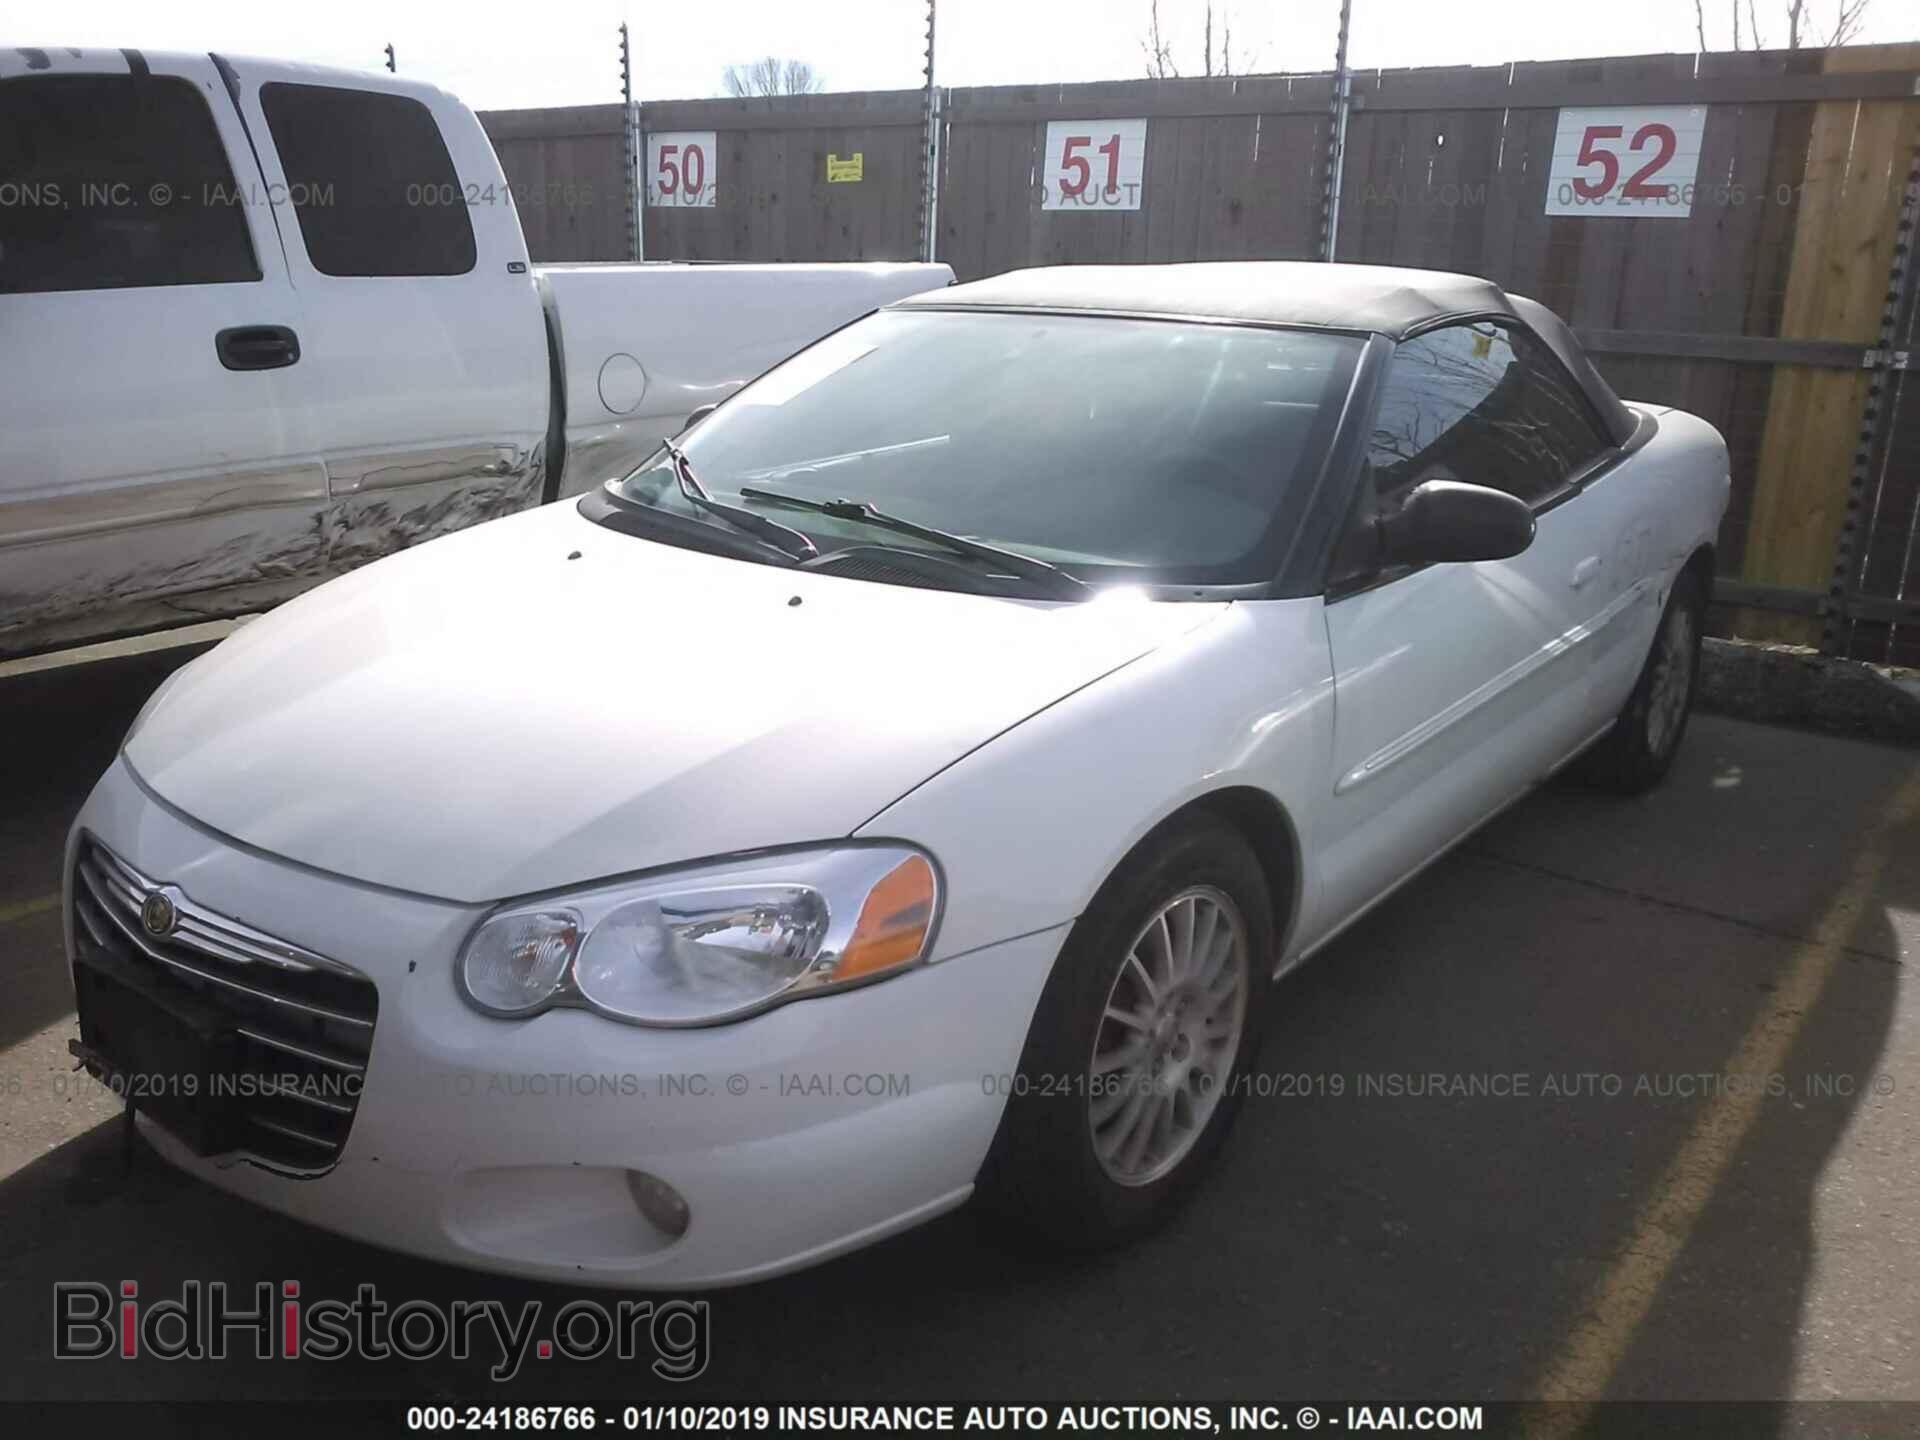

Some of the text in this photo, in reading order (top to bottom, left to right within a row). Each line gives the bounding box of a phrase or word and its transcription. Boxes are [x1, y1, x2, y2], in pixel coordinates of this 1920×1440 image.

[657, 144, 705, 195] 50
[1059, 133, 1122, 197] 51
[1571, 123, 1678, 199] 52
